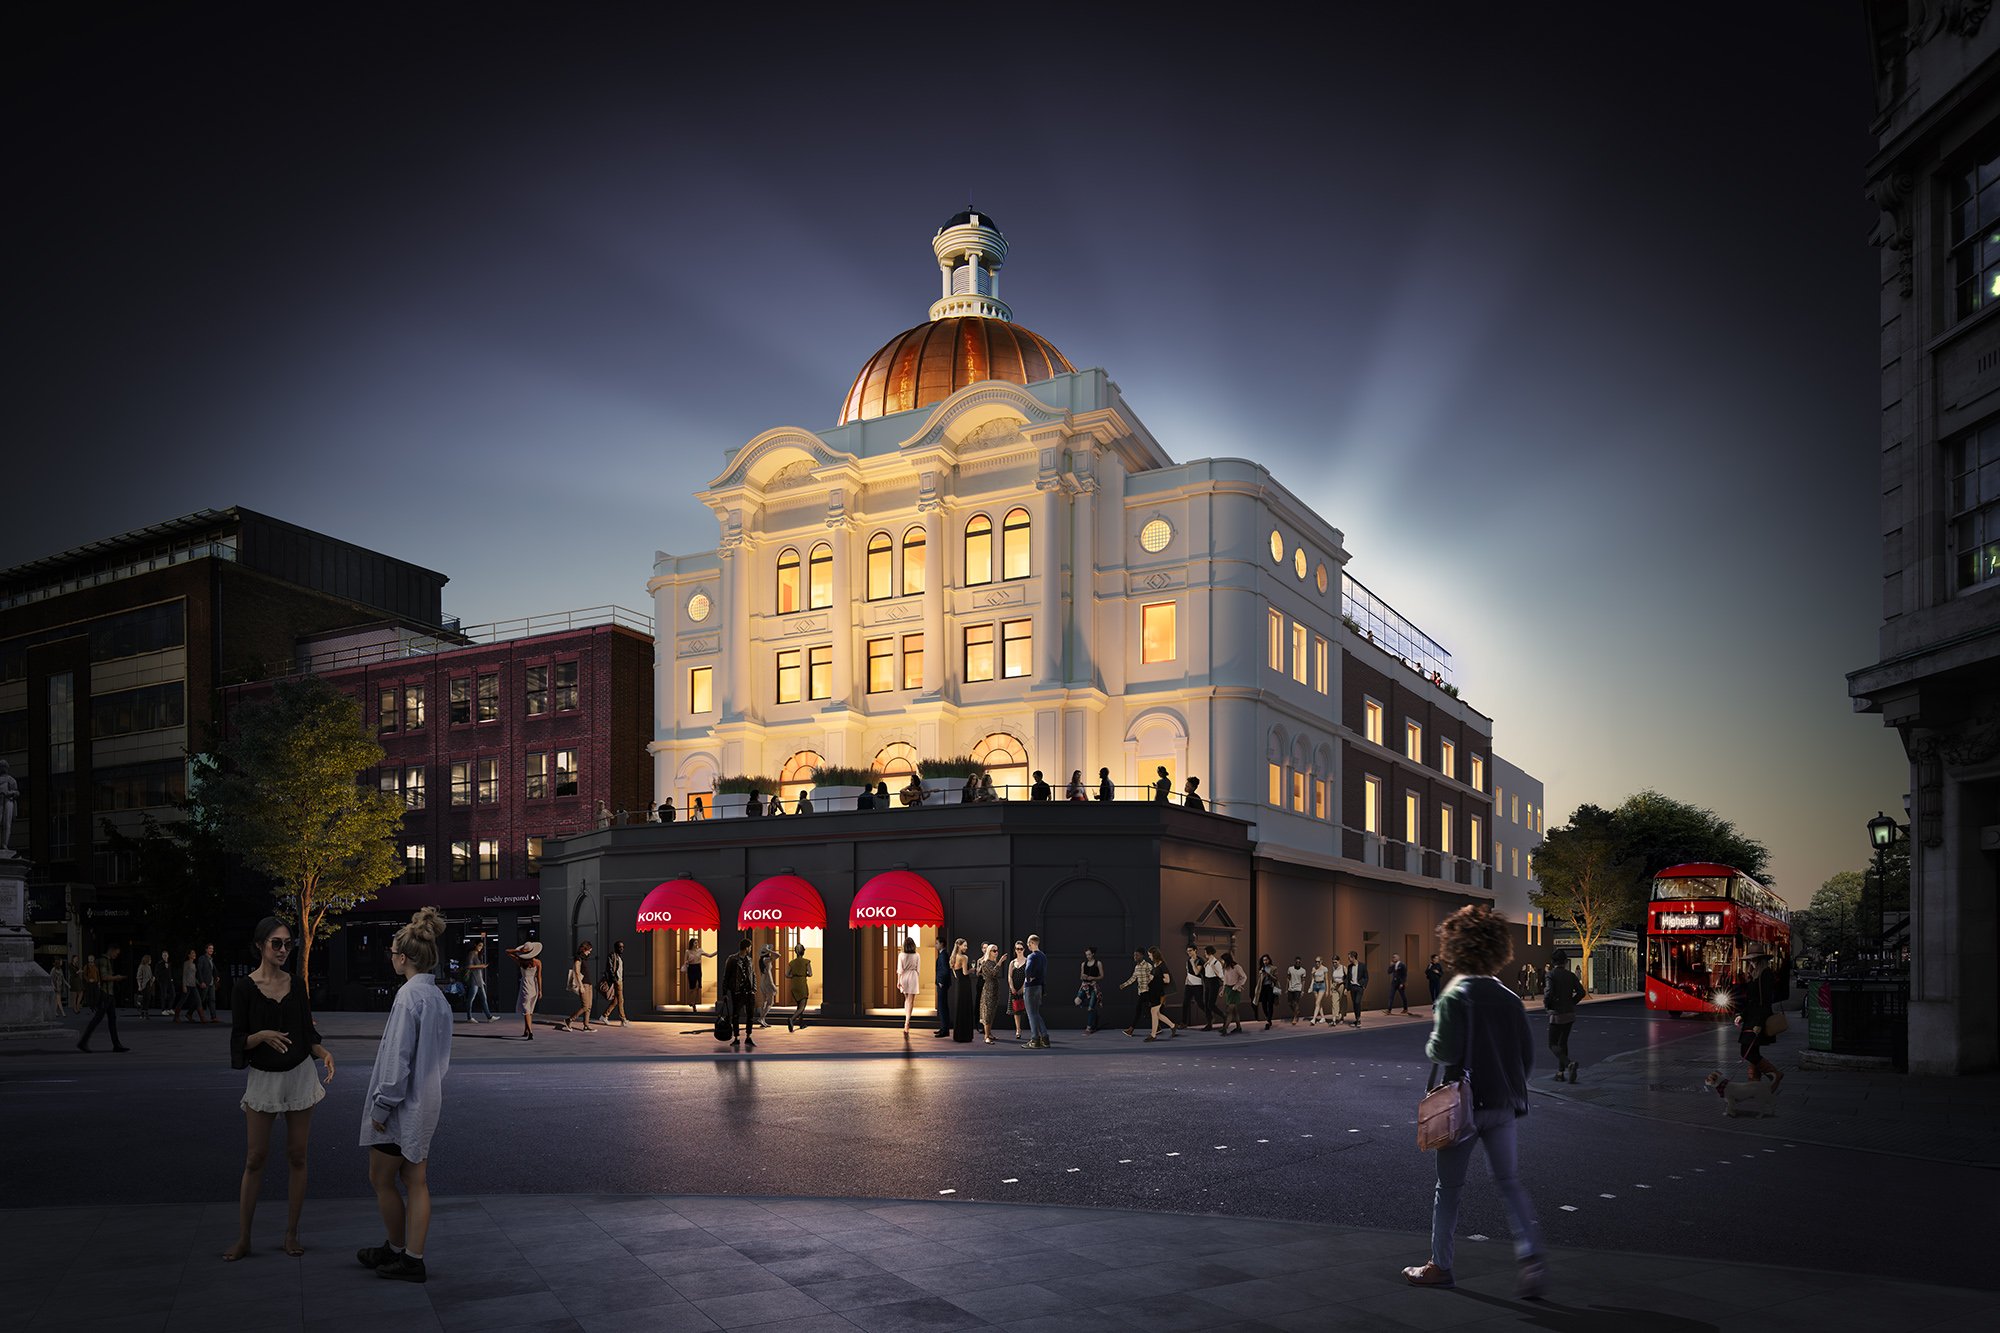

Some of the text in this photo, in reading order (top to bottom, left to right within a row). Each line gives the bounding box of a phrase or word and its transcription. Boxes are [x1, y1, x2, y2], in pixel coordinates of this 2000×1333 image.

[484, 895, 503, 904] Freshly
[504, 894, 529, 904] prepared
[637, 911, 672, 922] KOKO
[743, 909, 782, 921] KOKO
[857, 906, 897, 919] KOKO
[1661, 915, 1719, 928] Highgate 214
